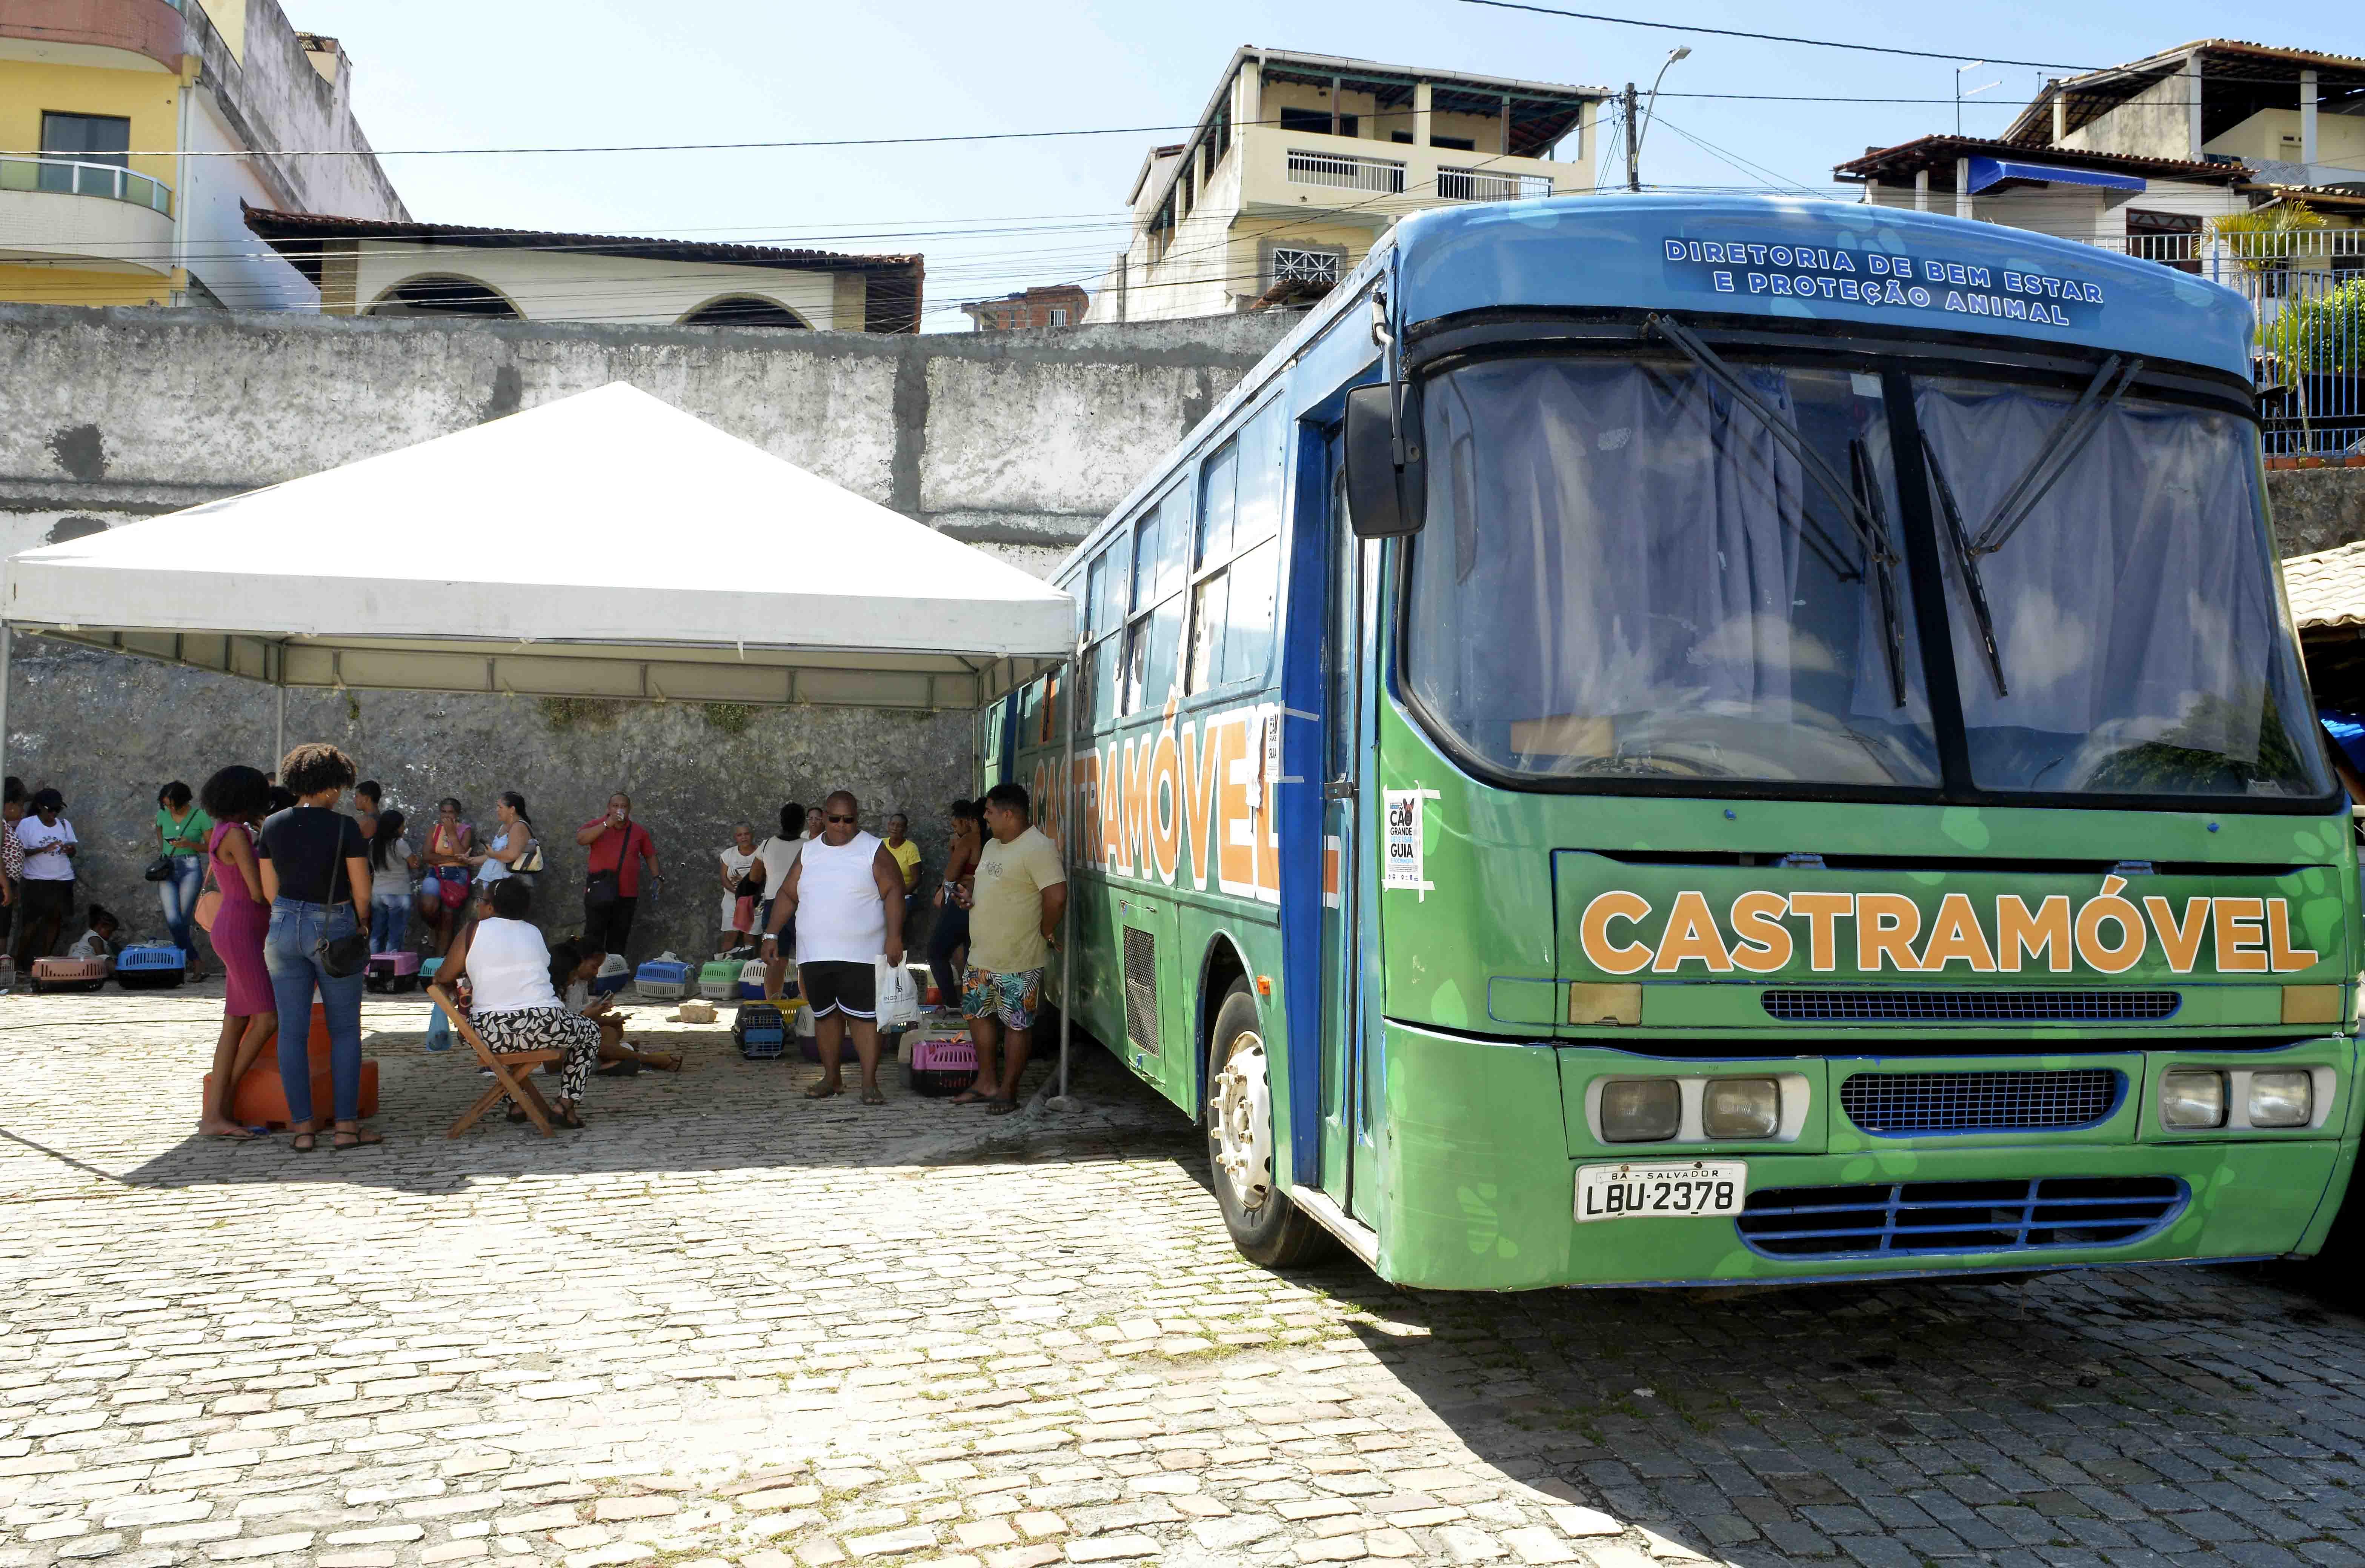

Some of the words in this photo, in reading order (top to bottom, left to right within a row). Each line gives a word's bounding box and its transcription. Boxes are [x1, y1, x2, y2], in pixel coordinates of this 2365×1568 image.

[1665, 240, 1855, 271] DIRETORIA
[1869, 254, 1911, 278] DE
[1926, 260, 1991, 287] BEM
[2005, 272, 2104, 303] ESTAR
[1713, 271, 1735, 292] E
[1748, 272, 1930, 307] PROTEÇÃO
[1946, 291, 2070, 326] ANIMAL
[1390, 807, 1413, 826] CÃO
[1390, 827, 1412, 836] GRANDE
[1391, 843, 1413, 858] GUIA
[1579, 875, 2318, 973] CASTRAMÓVEL
[1647, 1170, 1719, 1179] SALVADOR
